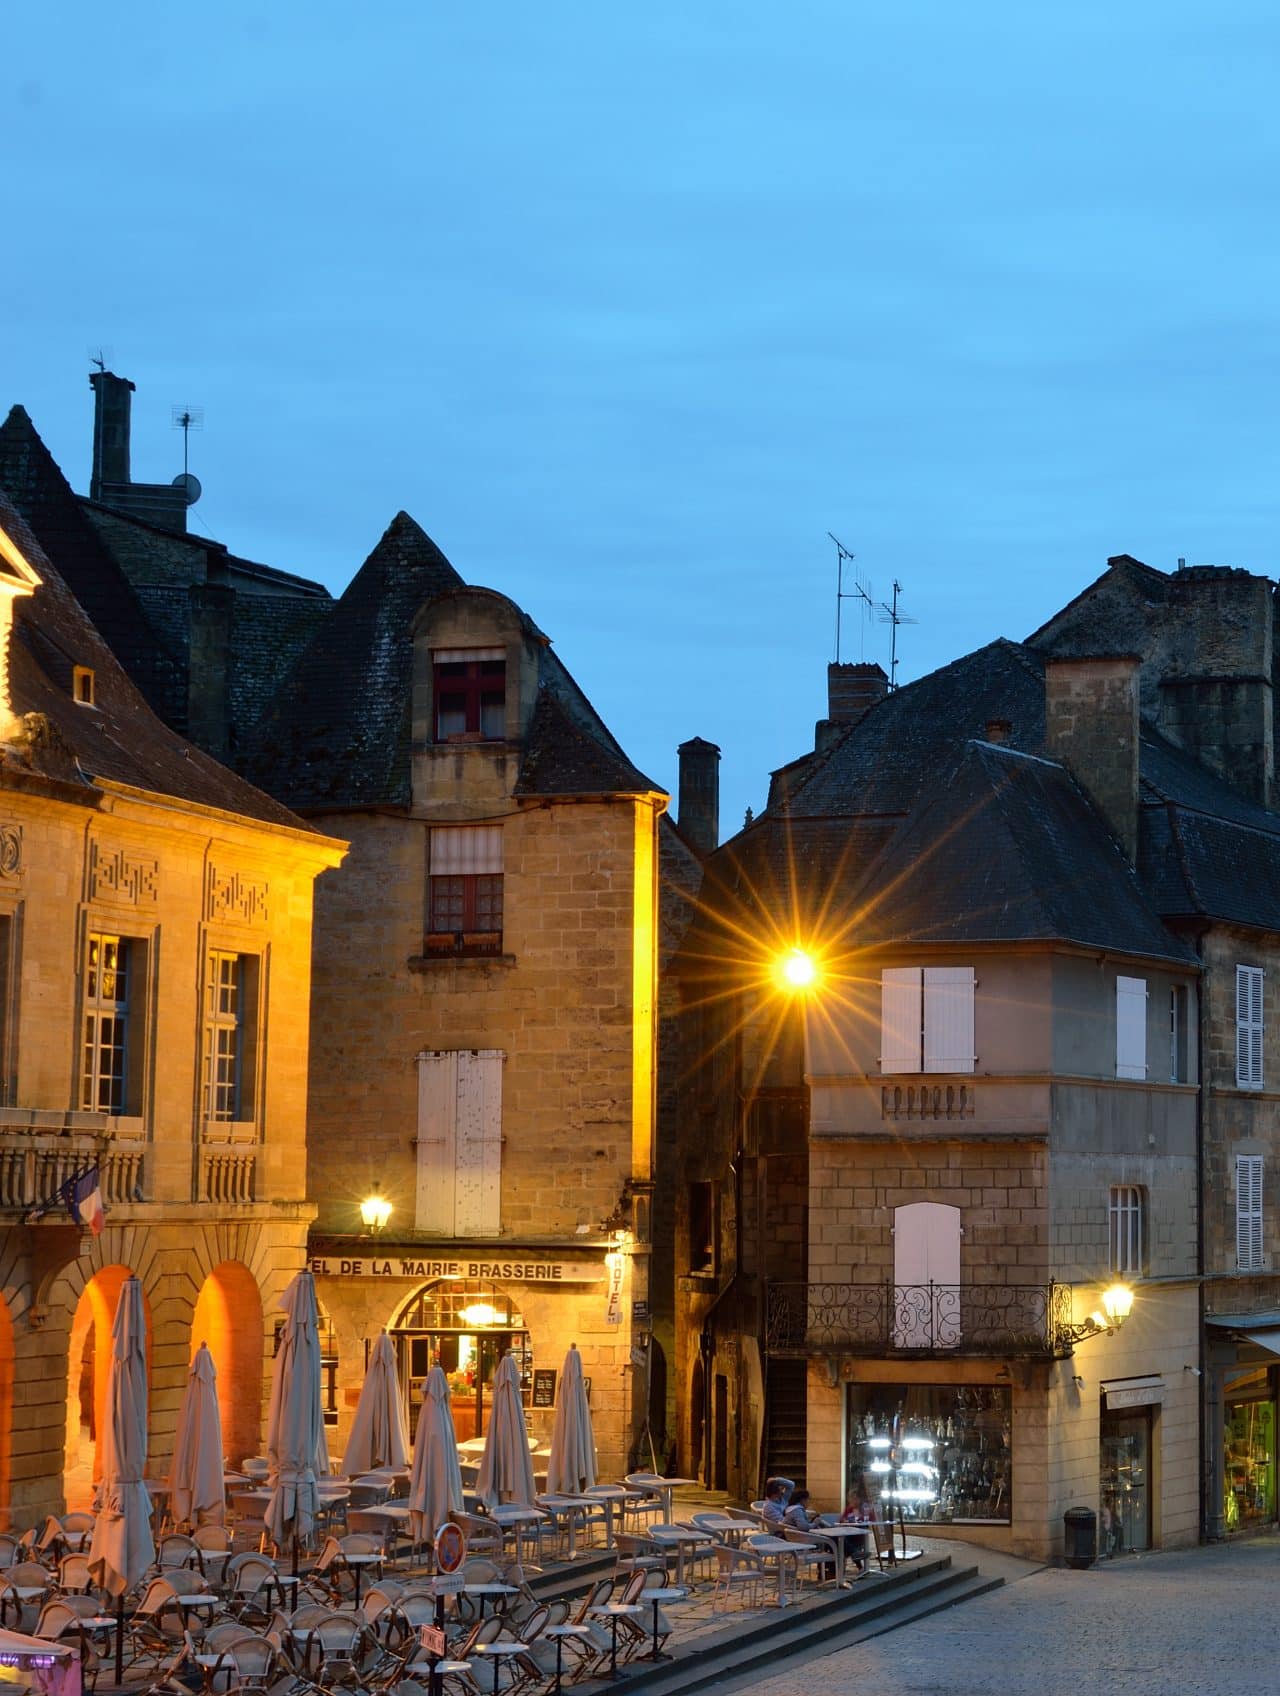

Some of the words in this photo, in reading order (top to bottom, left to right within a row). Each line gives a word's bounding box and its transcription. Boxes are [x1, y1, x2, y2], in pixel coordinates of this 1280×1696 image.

[309, 1259, 331, 1274] EL
[340, 1260, 362, 1275] DE
[372, 1261, 393, 1276] LA
[402, 1261, 459, 1277] MAIRIE
[468, 1263, 562, 1279] BRASSERIE
[607, 1257, 622, 1316] HOTEL
